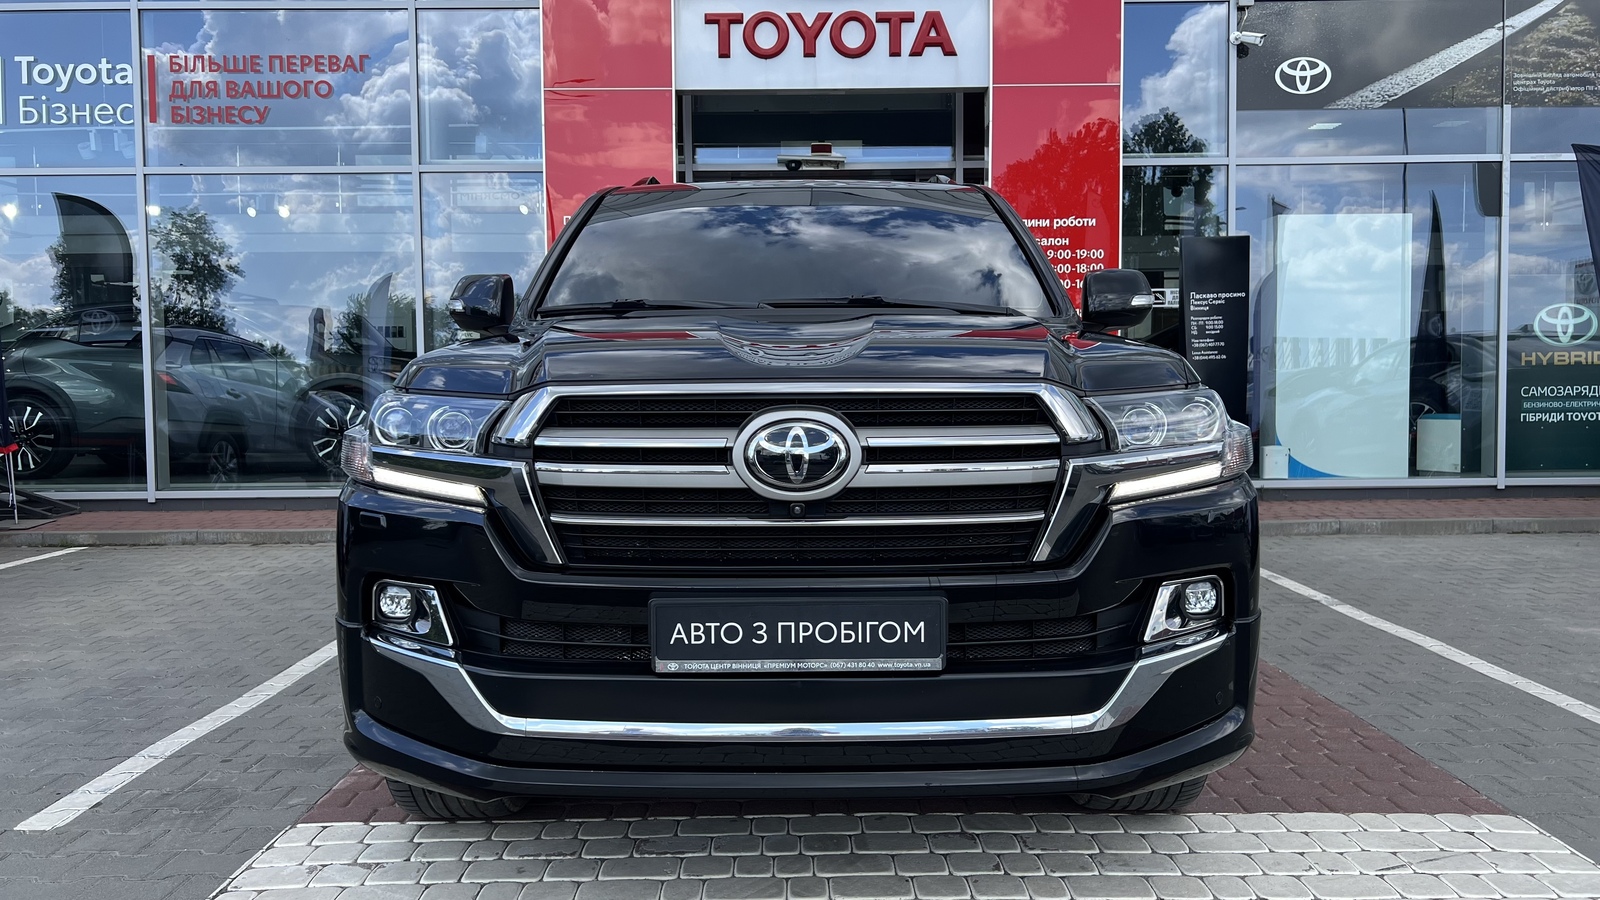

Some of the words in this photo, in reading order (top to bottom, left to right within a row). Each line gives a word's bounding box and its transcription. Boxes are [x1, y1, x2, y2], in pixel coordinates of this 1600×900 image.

[704, 10, 958, 60] TOYOTA
[14, 55, 134, 93] Toyota
[169, 54, 262, 74] БІЛЬШЕ
[268, 54, 371, 74] ПЕРЕВАГ
[169, 80, 219, 102] ДЛЯ
[225, 79, 334, 99] ВАШОГО
[19, 95, 134, 125] Бізнес
[170, 105, 270, 125] БІЗНЕСУ
[1053, 216, 1097, 230] роботи
[1520, 385, 1600, 397] САМОЗАРЯД
[1523, 400, 1600, 409] БЕНЗИНОВО-ЕЛЕКТРИЧ
[1520, 412, 1564, 423] ГІБРИДИ
[1566, 411, 1600, 421] TOYOT
[669, 622, 743, 645] АВТО
[777, 621, 925, 644] ПРОБІГОМ
[683, 662, 710, 670] ТОЙОТА
[710, 662, 731, 671] ЦЕНТР
[732, 662, 761, 670] ВІННИЦЯ
[829, 661, 847, 670] (067)
[847, 661, 858, 669] 431
[858, 661, 867, 669] 80
[867, 661, 876, 669] 40
[877, 661, 932, 670] www.toyota.vn.ua
